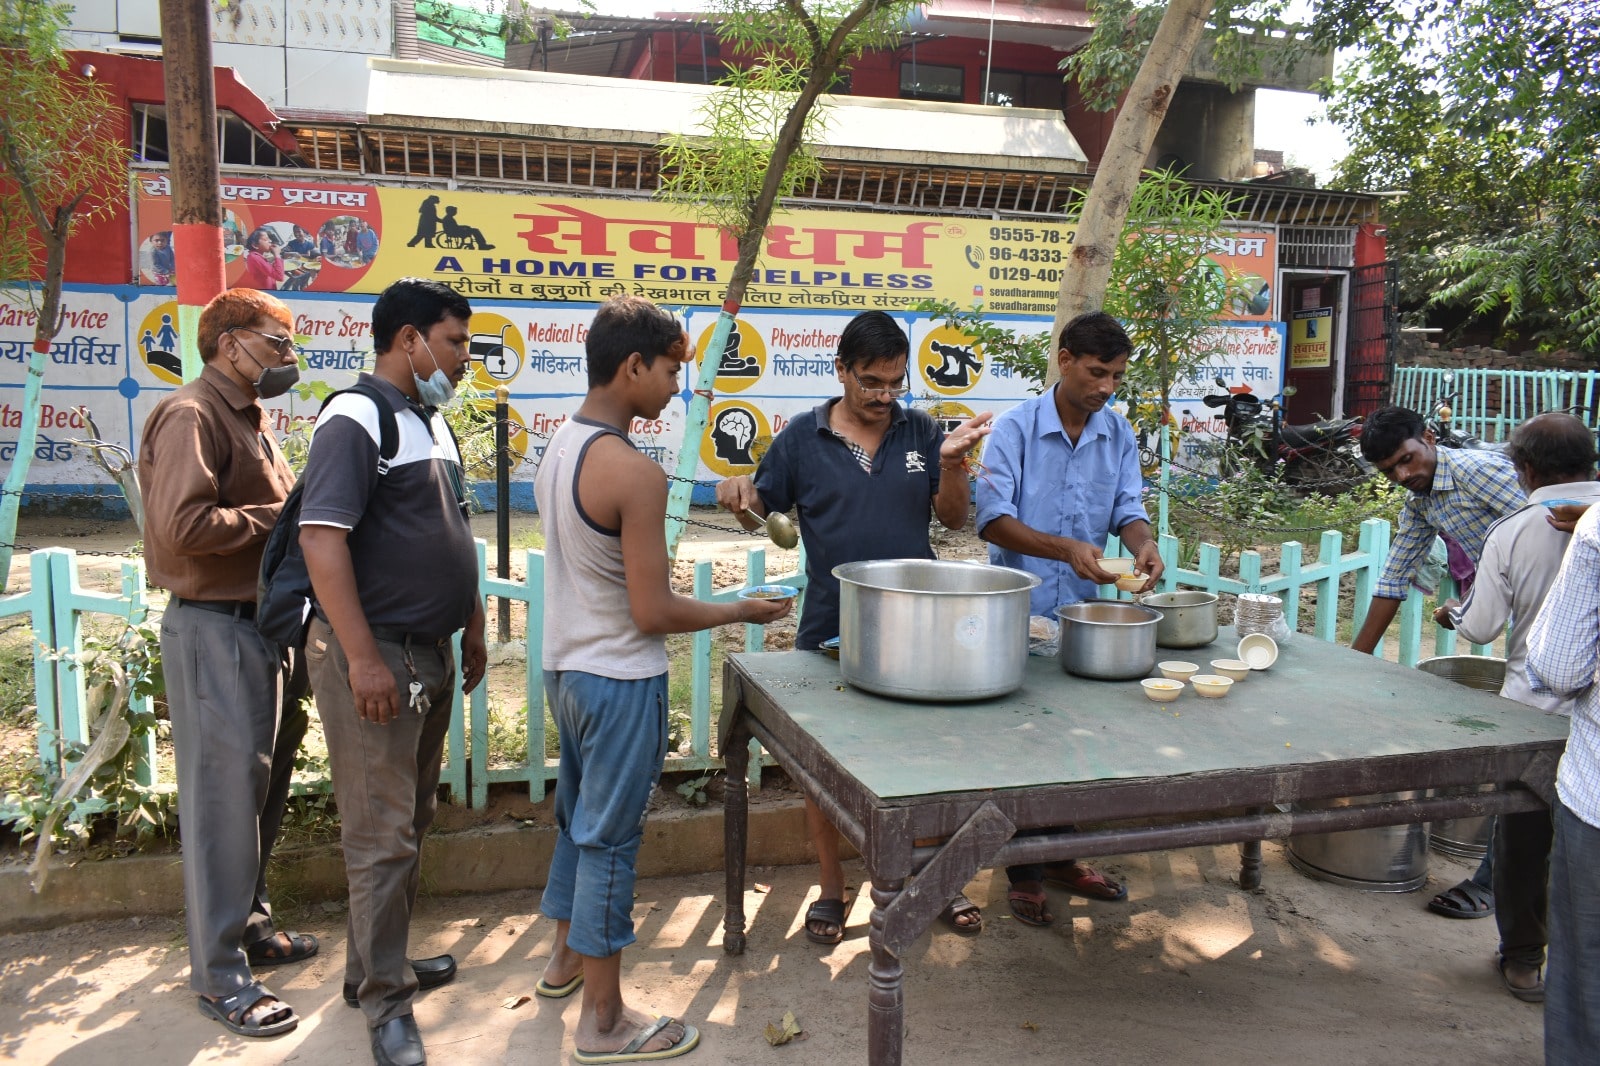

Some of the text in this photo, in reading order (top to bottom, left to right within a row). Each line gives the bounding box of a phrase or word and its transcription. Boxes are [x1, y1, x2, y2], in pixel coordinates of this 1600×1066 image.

[281, 187, 368, 207] प्रयास
[513, 203, 944, 269] सेवाधर्म
[433, 255, 464, 272] A
[482, 257, 615, 278] HOME
[633, 263, 717, 282] FOR
[509, 283, 524, 295] व
[788, 288, 866, 307] लोकप्रिय
[294, 314, 335, 336] Care
[528, 321, 574, 343] Medical
[51, 335, 122, 366] सर्विस
[531, 349, 583, 377] मेडिकल
[40, 405, 87, 429] Bed
[1181, 416, 1211, 433] Patient
